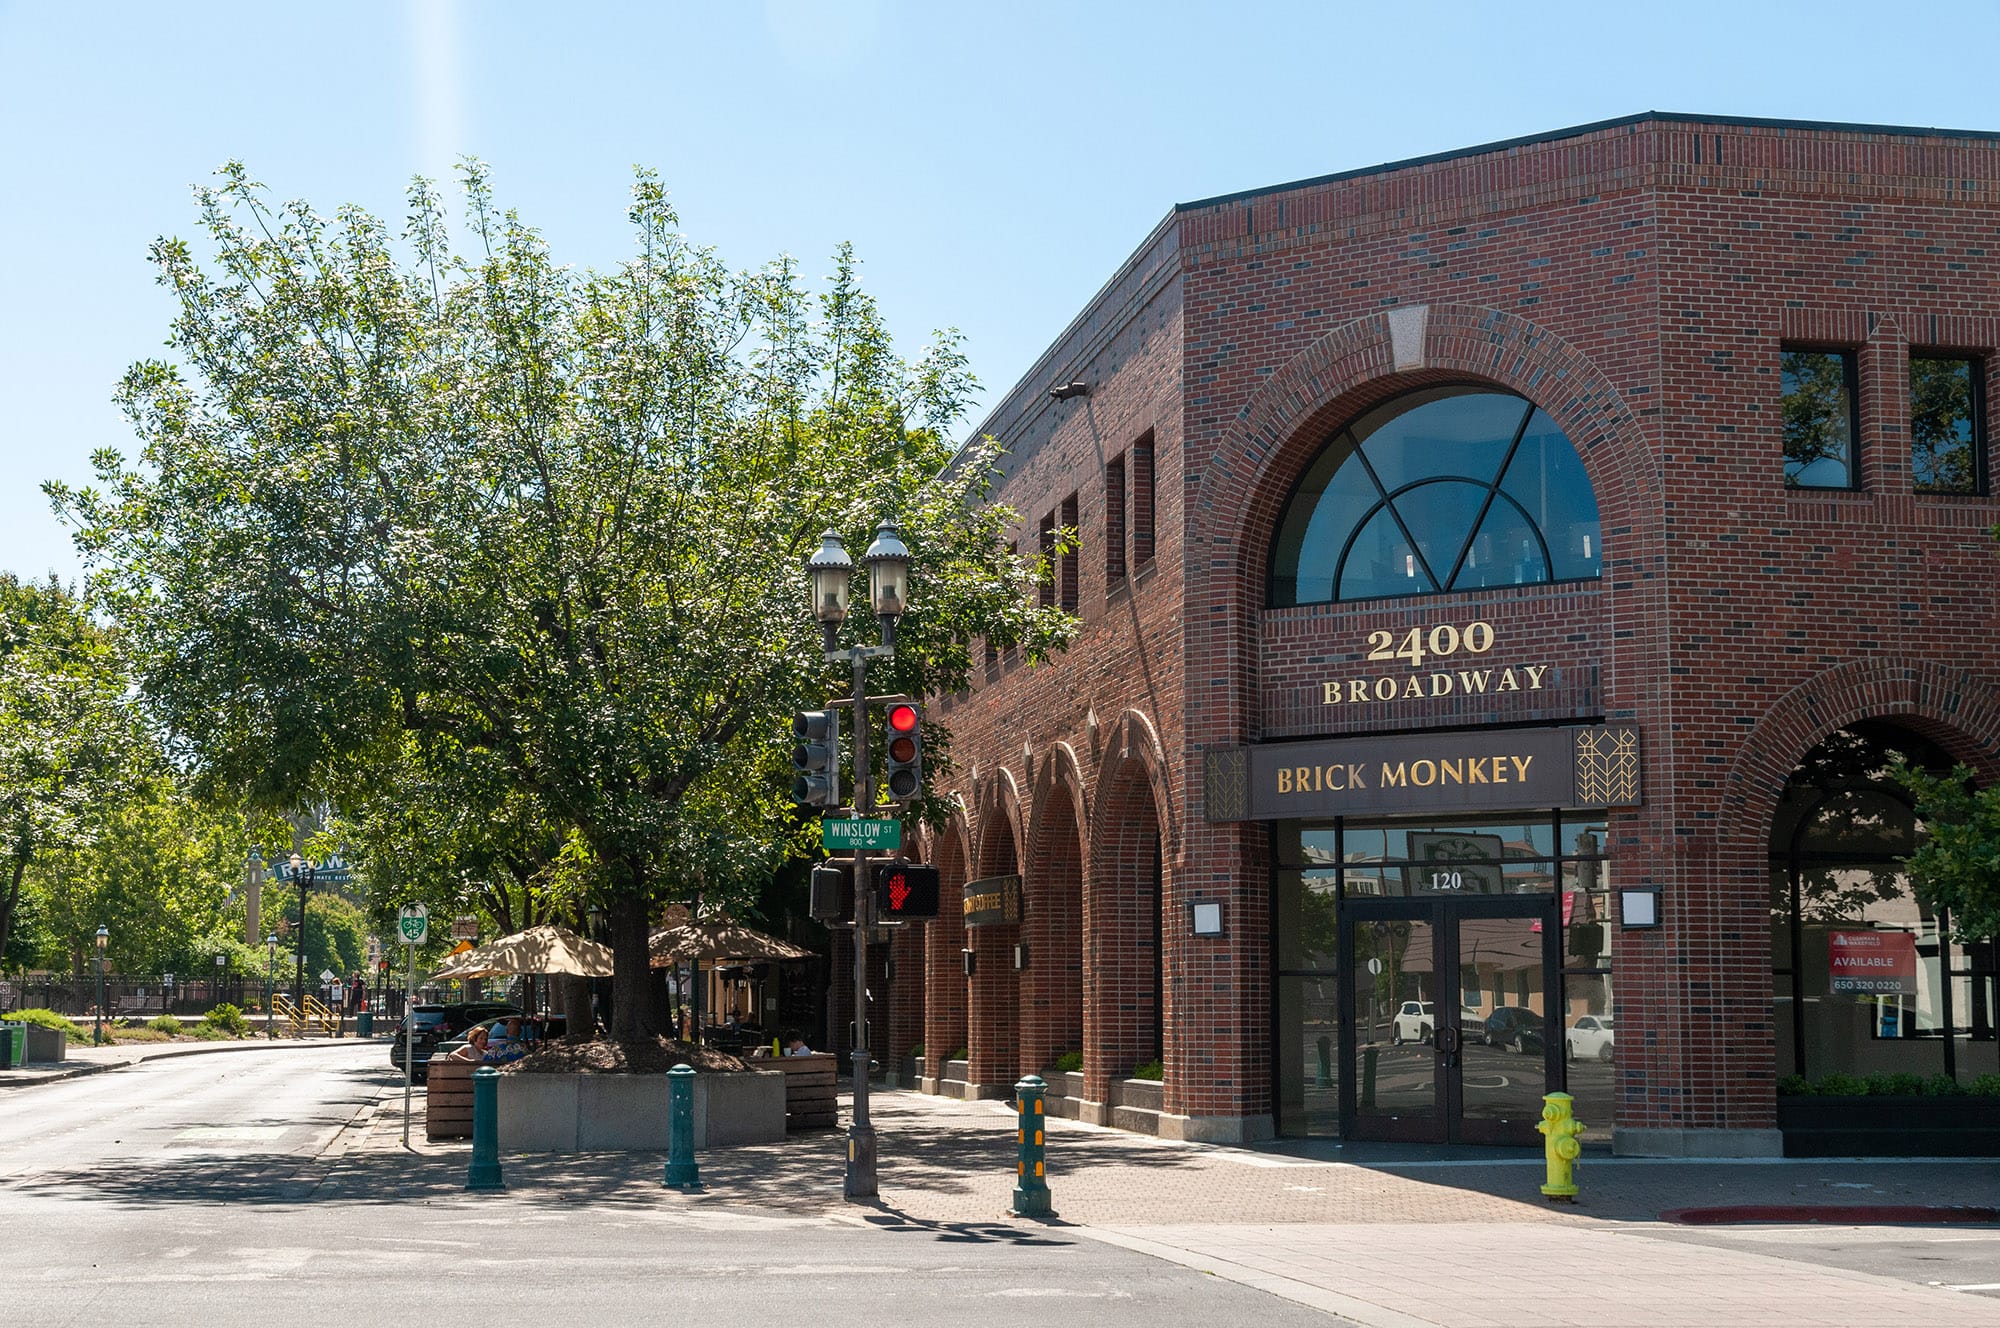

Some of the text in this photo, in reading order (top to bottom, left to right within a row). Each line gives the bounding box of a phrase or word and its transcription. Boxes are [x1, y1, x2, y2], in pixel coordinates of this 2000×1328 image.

[1367, 621, 1495, 667] 2400
[1322, 665, 1548, 705] BROADWAY
[1277, 755, 1534, 794] BRICK MONKEY
[831, 822, 893, 837] WINSLOW ST
[849, 838, 863, 846] 800
[1431, 871, 1462, 890] 120
[406, 928, 420, 938] 45
[1833, 957, 1894, 967] AVAILABLE
[1834, 981, 1902, 990] 650 320 0220
